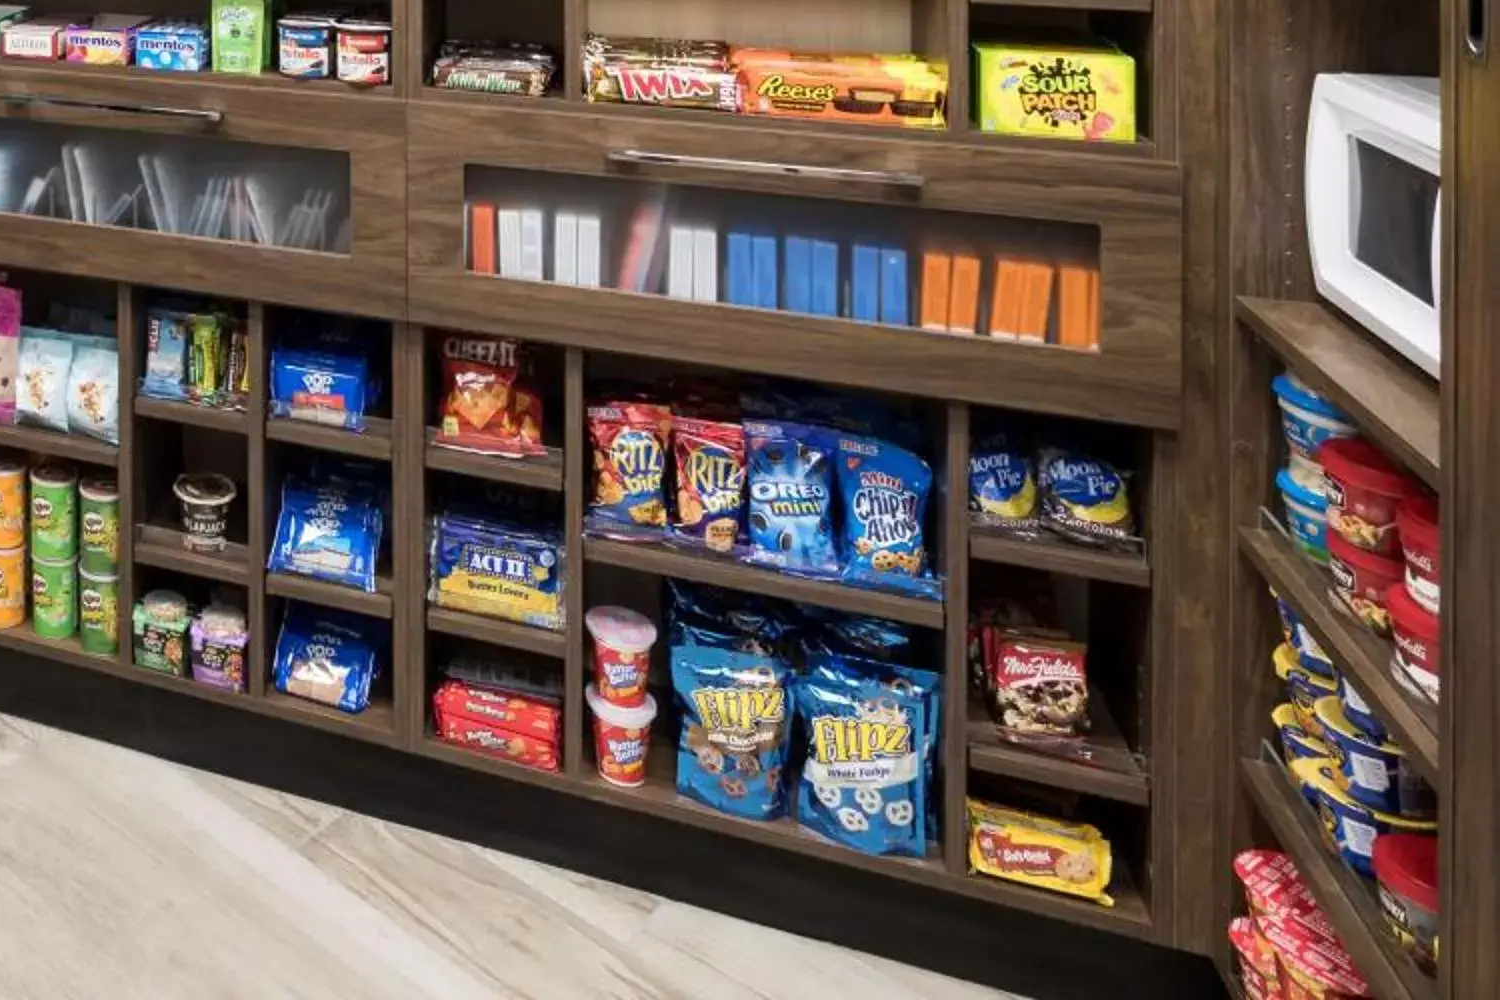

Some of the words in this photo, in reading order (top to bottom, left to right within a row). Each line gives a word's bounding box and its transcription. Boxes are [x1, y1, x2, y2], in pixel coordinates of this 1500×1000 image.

[68, 34, 122, 49] mentos
[139, 38, 195, 53] mentos
[758, 74, 837, 101] Reese's
[1022, 75, 1092, 94] SOUR
[1021, 93, 1097, 110] PATCH
[612, 439, 665, 475] RITZ
[686, 452, 743, 491] RITZ
[750, 482, 826, 501] OREO
[1086, 474, 1116, 496] Pie
[469, 553, 504, 575] ACT
